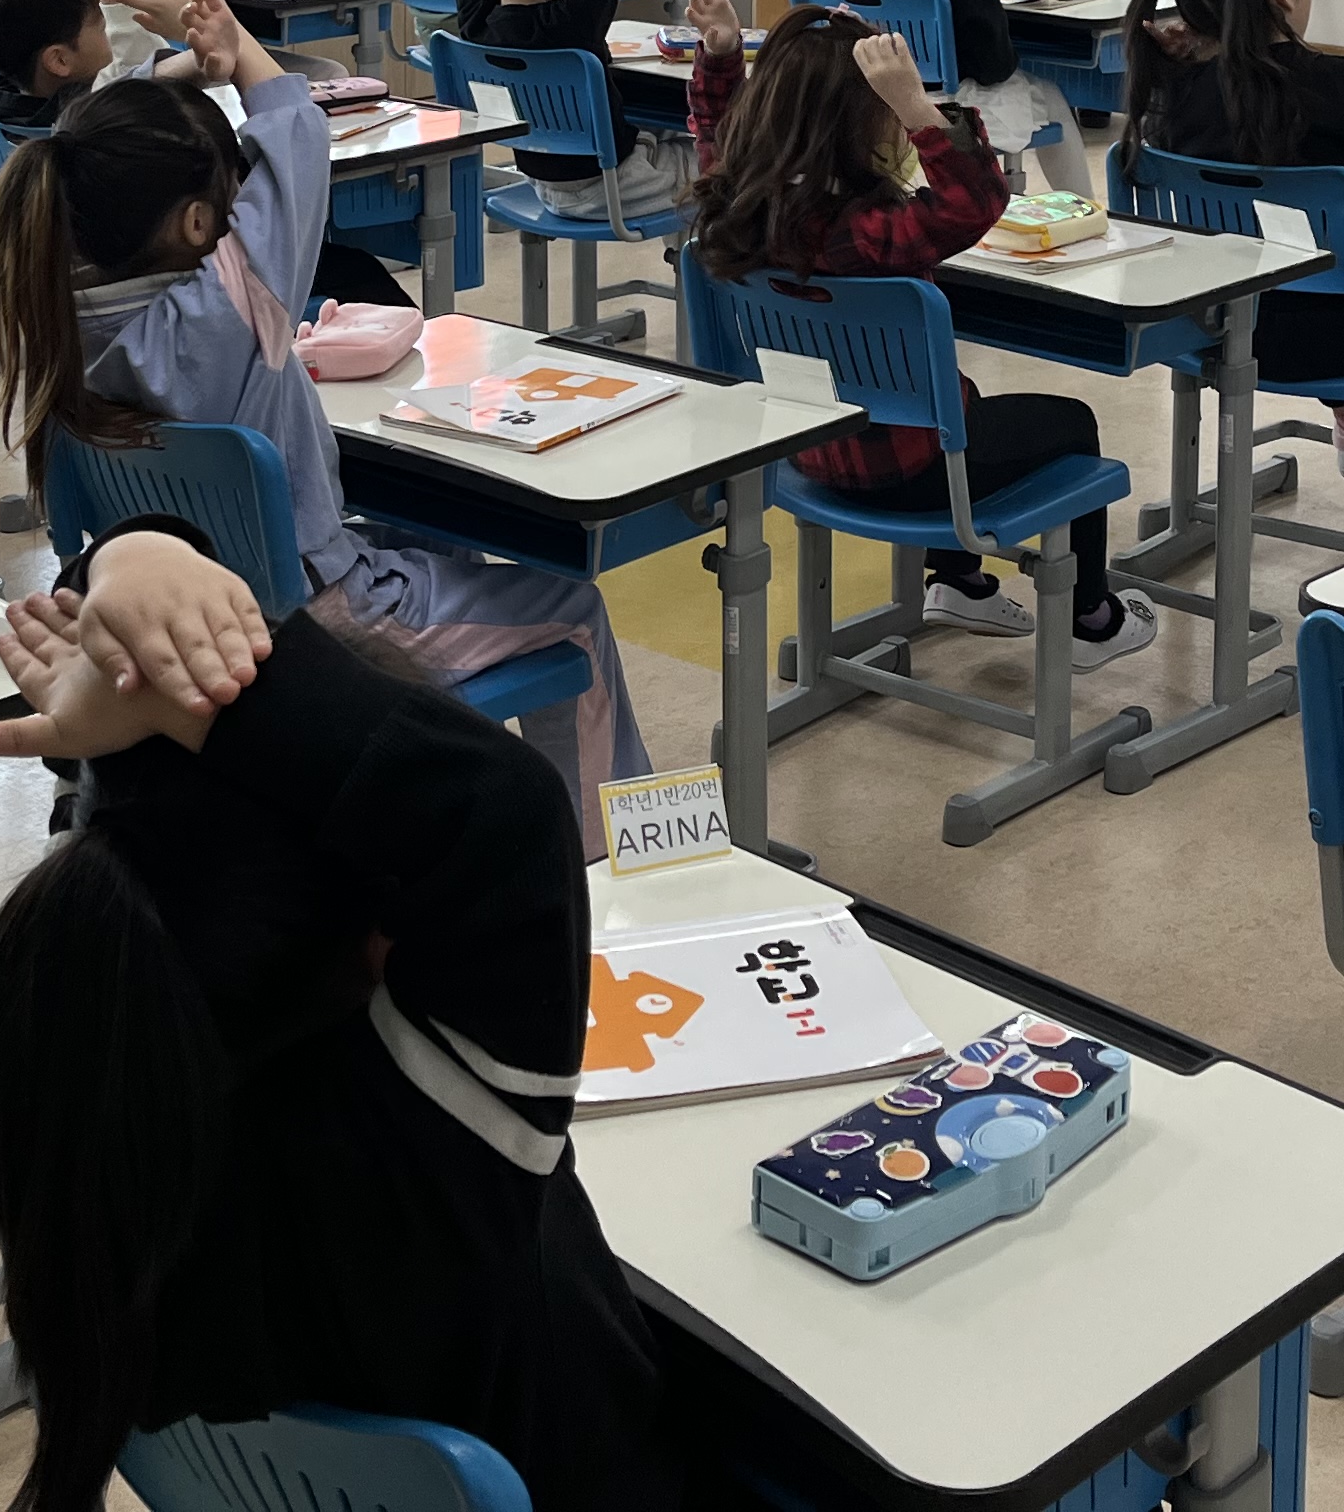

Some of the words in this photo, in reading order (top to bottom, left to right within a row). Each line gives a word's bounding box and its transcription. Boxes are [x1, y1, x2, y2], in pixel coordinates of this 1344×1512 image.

[616, 810, 729, 859] ARINA
[735, 939, 820, 1004] 학교
[786, 1008, 826, 1037] 1-1
